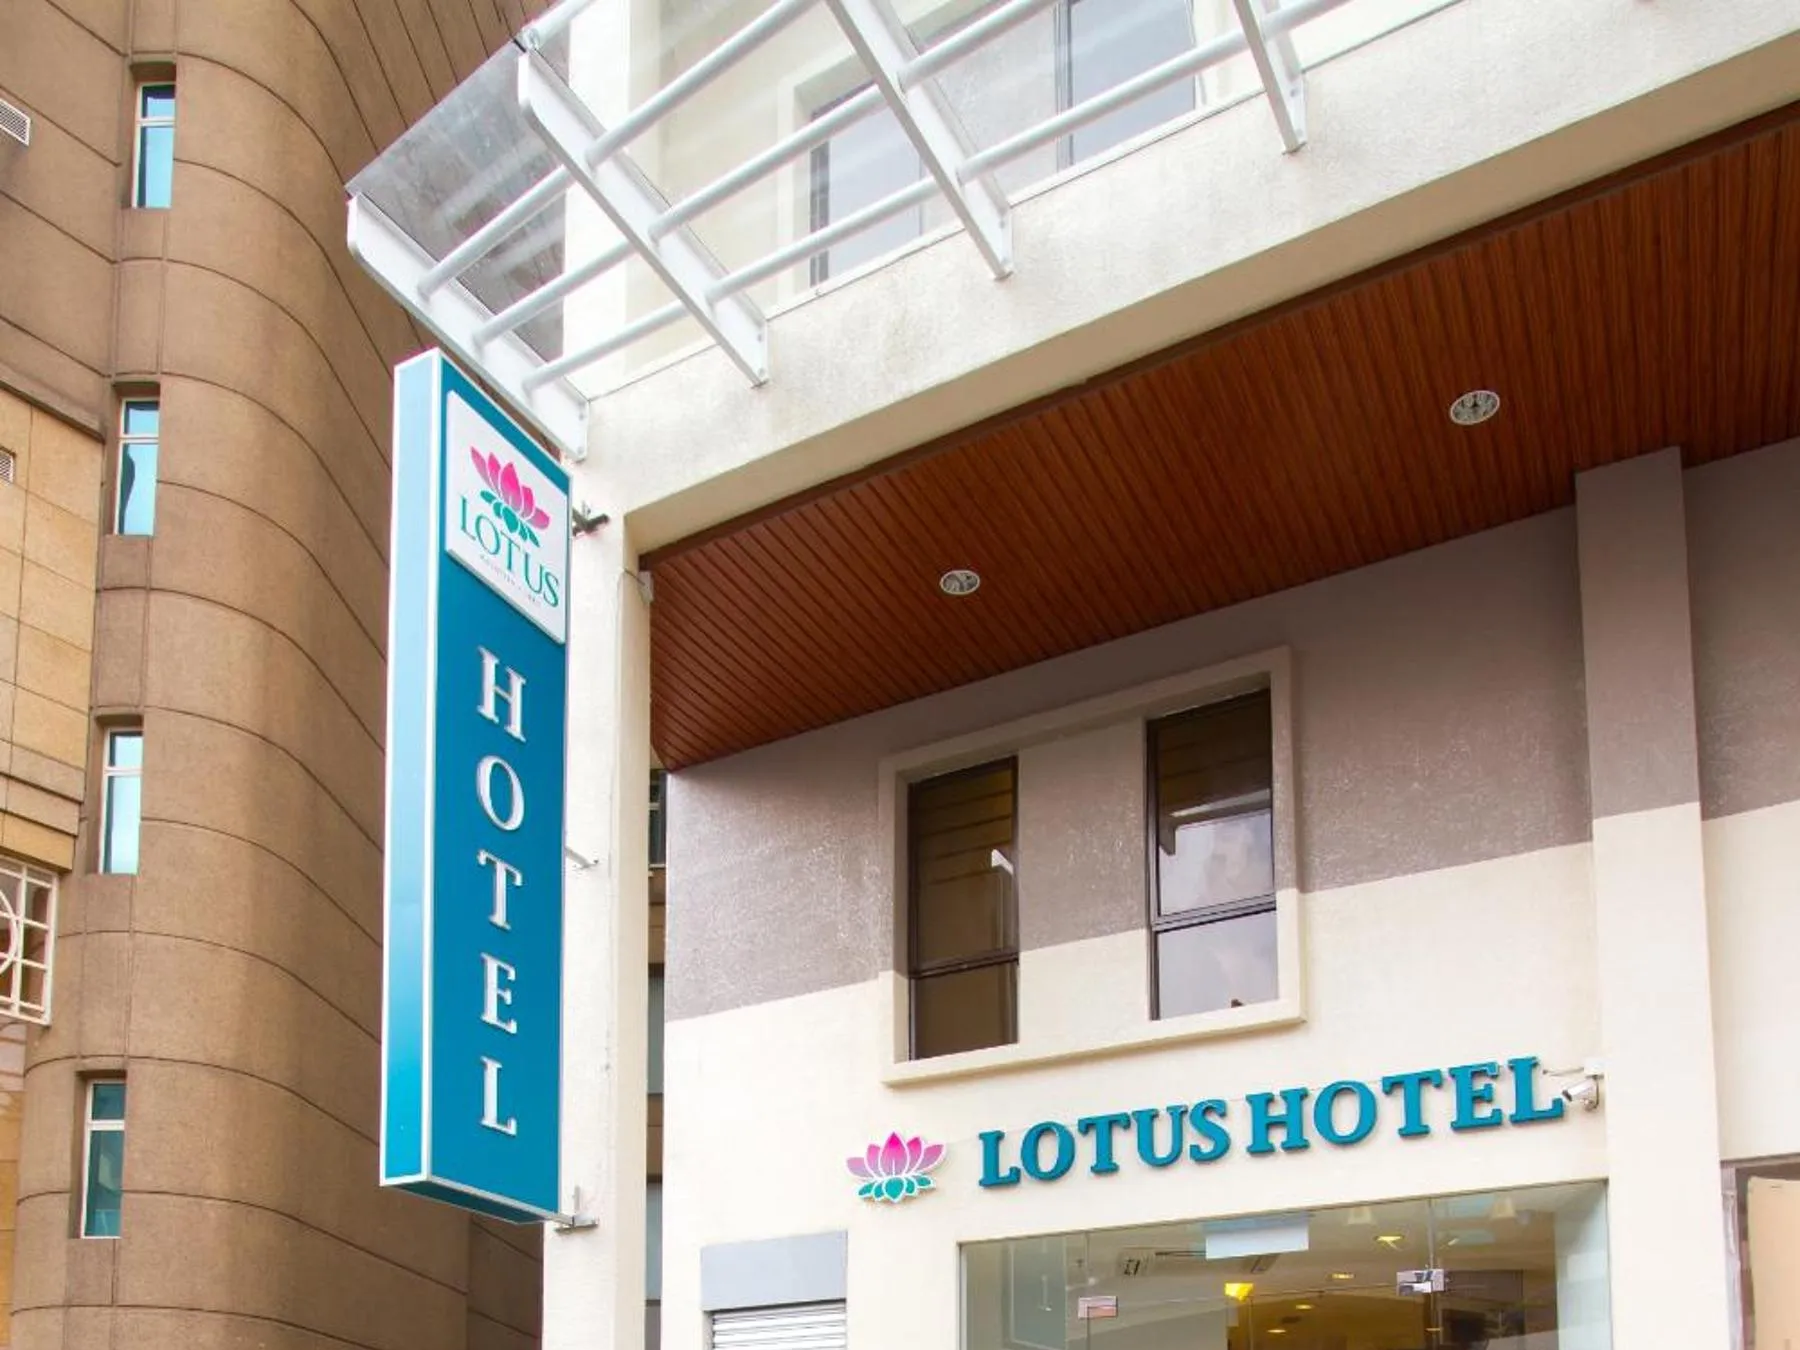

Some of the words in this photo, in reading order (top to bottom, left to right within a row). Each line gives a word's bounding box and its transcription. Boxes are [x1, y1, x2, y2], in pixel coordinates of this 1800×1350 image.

[458, 494, 560, 609] LOTUS
[475, 646, 527, 1137] HOTEL
[978, 1098, 1232, 1189] LOTUS
[1244, 1055, 1566, 1156] HOTEL
